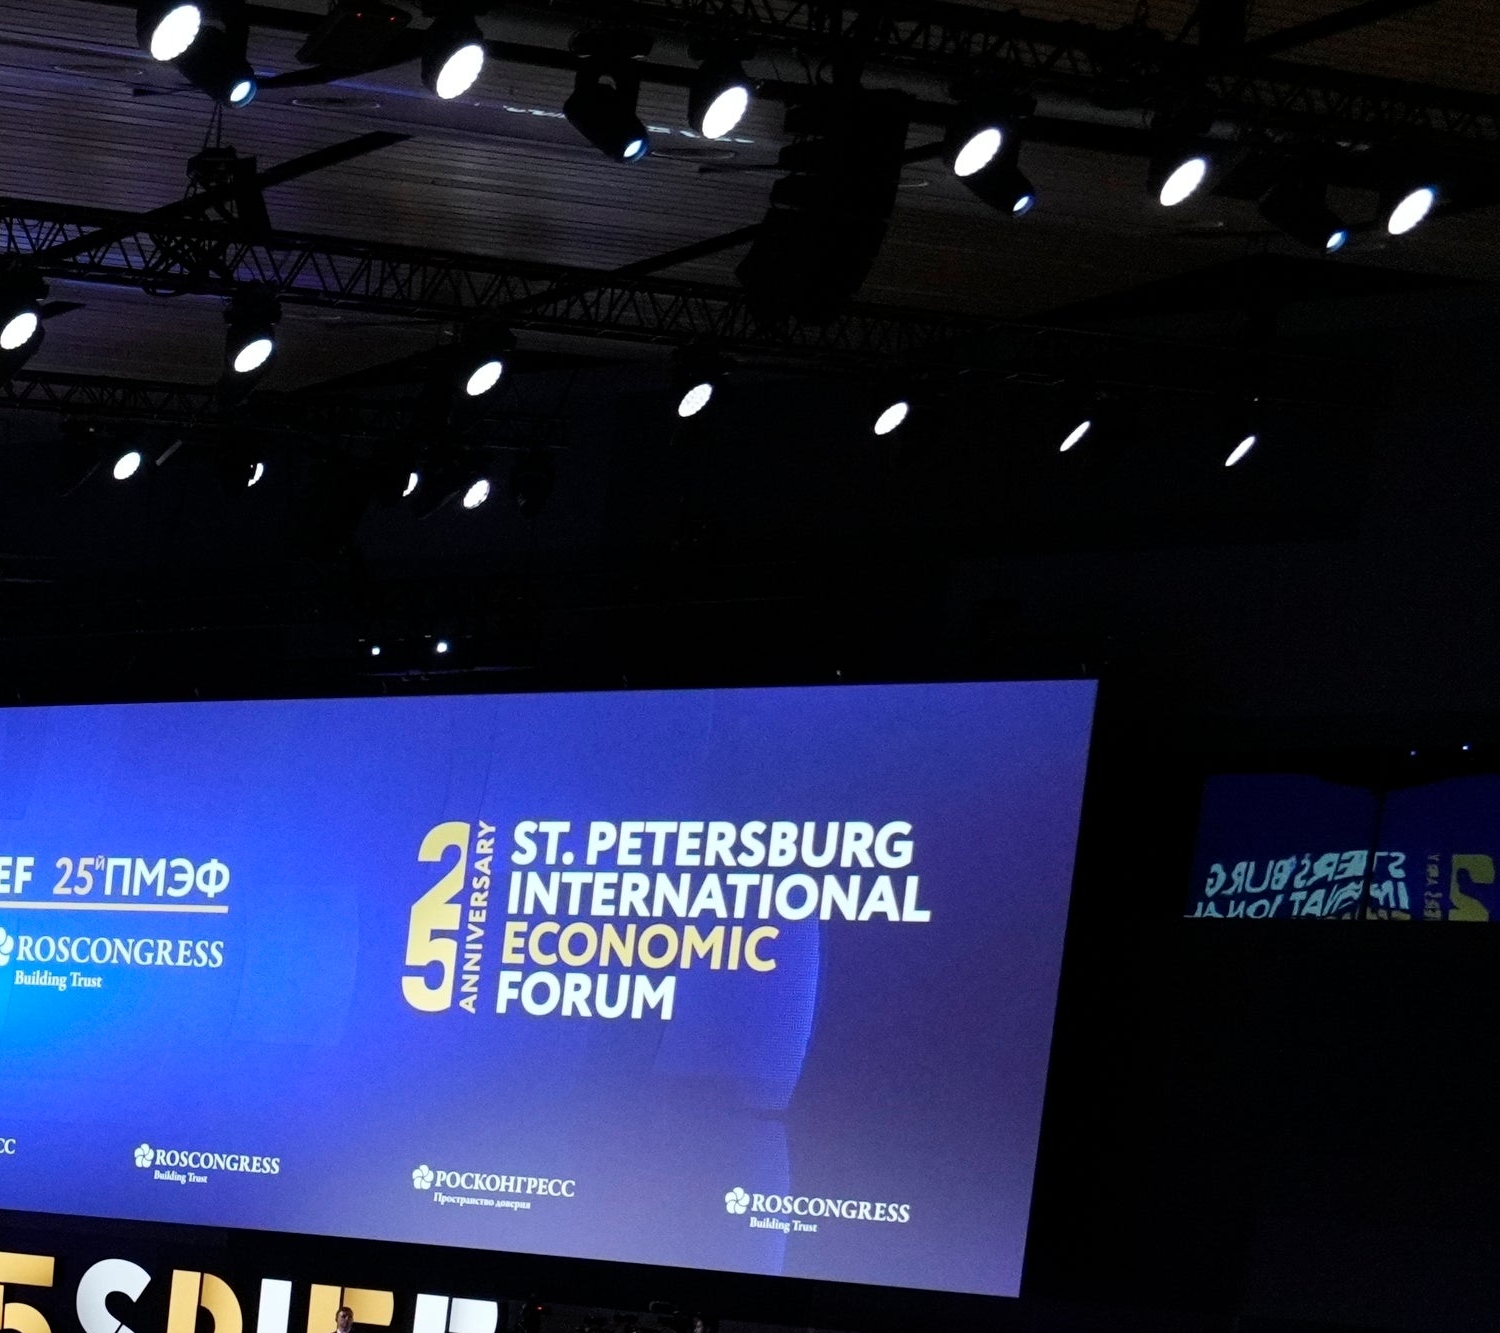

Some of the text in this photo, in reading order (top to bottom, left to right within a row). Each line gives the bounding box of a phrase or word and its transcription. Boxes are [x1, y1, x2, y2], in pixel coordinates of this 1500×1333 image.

[510, 820, 915, 869] ST. PETERSBURG
[104, 856, 230, 899] ПМЭФ
[506, 871, 931, 923] INTERNATIONAL
[401, 820, 471, 1013] 25
[458, 820, 498, 1014] ANNIVERSARY
[16, 935, 224, 969] ROSCONGRESS
[500, 921, 780, 973] ECONOMIC
[14, 970, 102, 991] Building Trust
[495, 971, 677, 1021] FORUM
[154, 1148, 280, 1175] ROSCONGRESS
[154, 1169, 208, 1185] Building Trust
[433, 1191, 495, 1208] Пространство
[434, 1170, 576, 1199] РОСКОНГРЕСС
[750, 1216, 817, 1234] Building Trust
[751, 1193, 910, 1224] ROSCONGRESS
